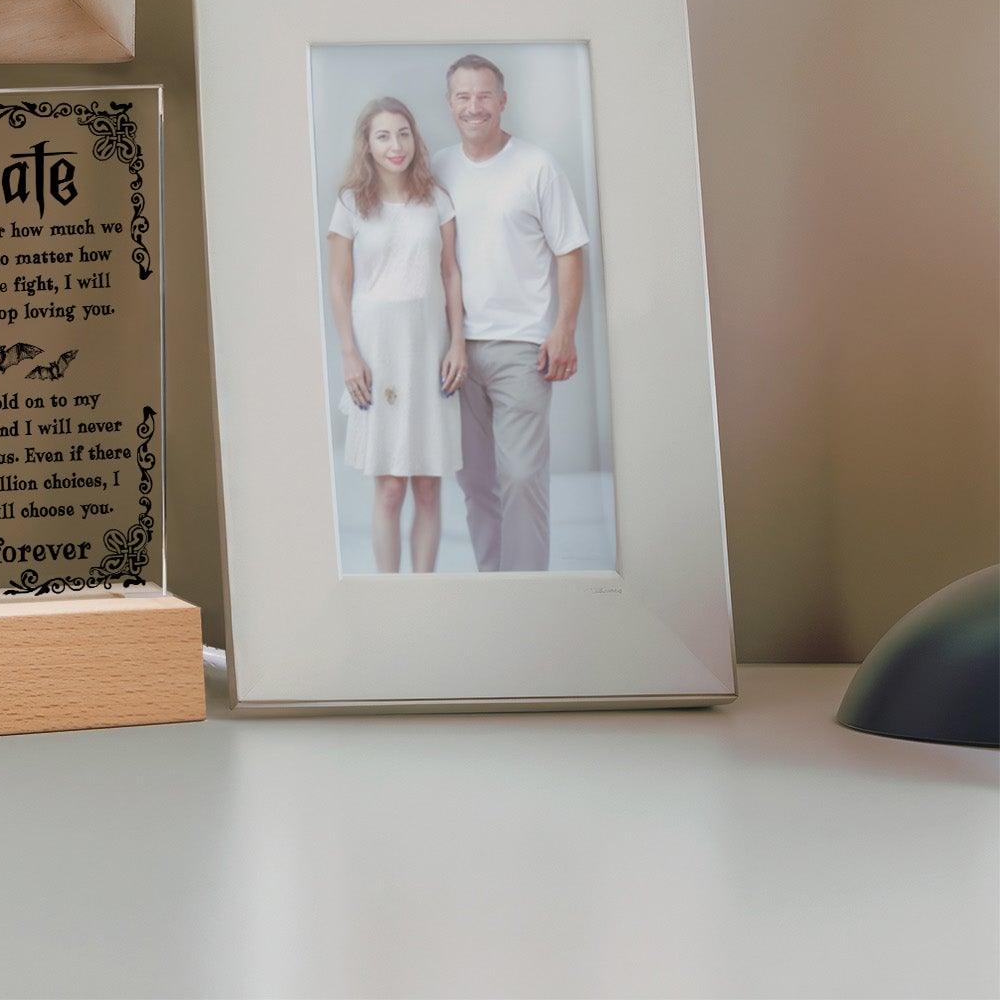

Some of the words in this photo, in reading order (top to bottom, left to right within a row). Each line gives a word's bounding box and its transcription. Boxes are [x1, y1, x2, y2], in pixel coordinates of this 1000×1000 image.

[10, 221, 45, 238] how
[49, 218, 96, 237] much
[99, 222, 124, 234] we
[14, 250, 74, 266] matter
[77, 245, 113, 263] how
[13, 274, 59, 297] fight,
[64, 273, 73, 290] I
[76, 271, 112, 290] will
[23, 301, 77, 323] loving
[81, 304, 116, 321] you.
[24, 397, 45, 409] on
[49, 393, 68, 408] to
[72, 393, 102, 410] my
[24, 419, 33, 436] I
[37, 417, 73, 435] will
[77, 420, 123, 434] never
[24, 446, 65, 464] Even
[69, 444, 85, 462] if
[87, 442, 132, 461] there
[43, 472, 108, 492] choices,
[112, 470, 121, 487] I
[20, 500, 76, 519] choose
[79, 502, 114, 520] you.
